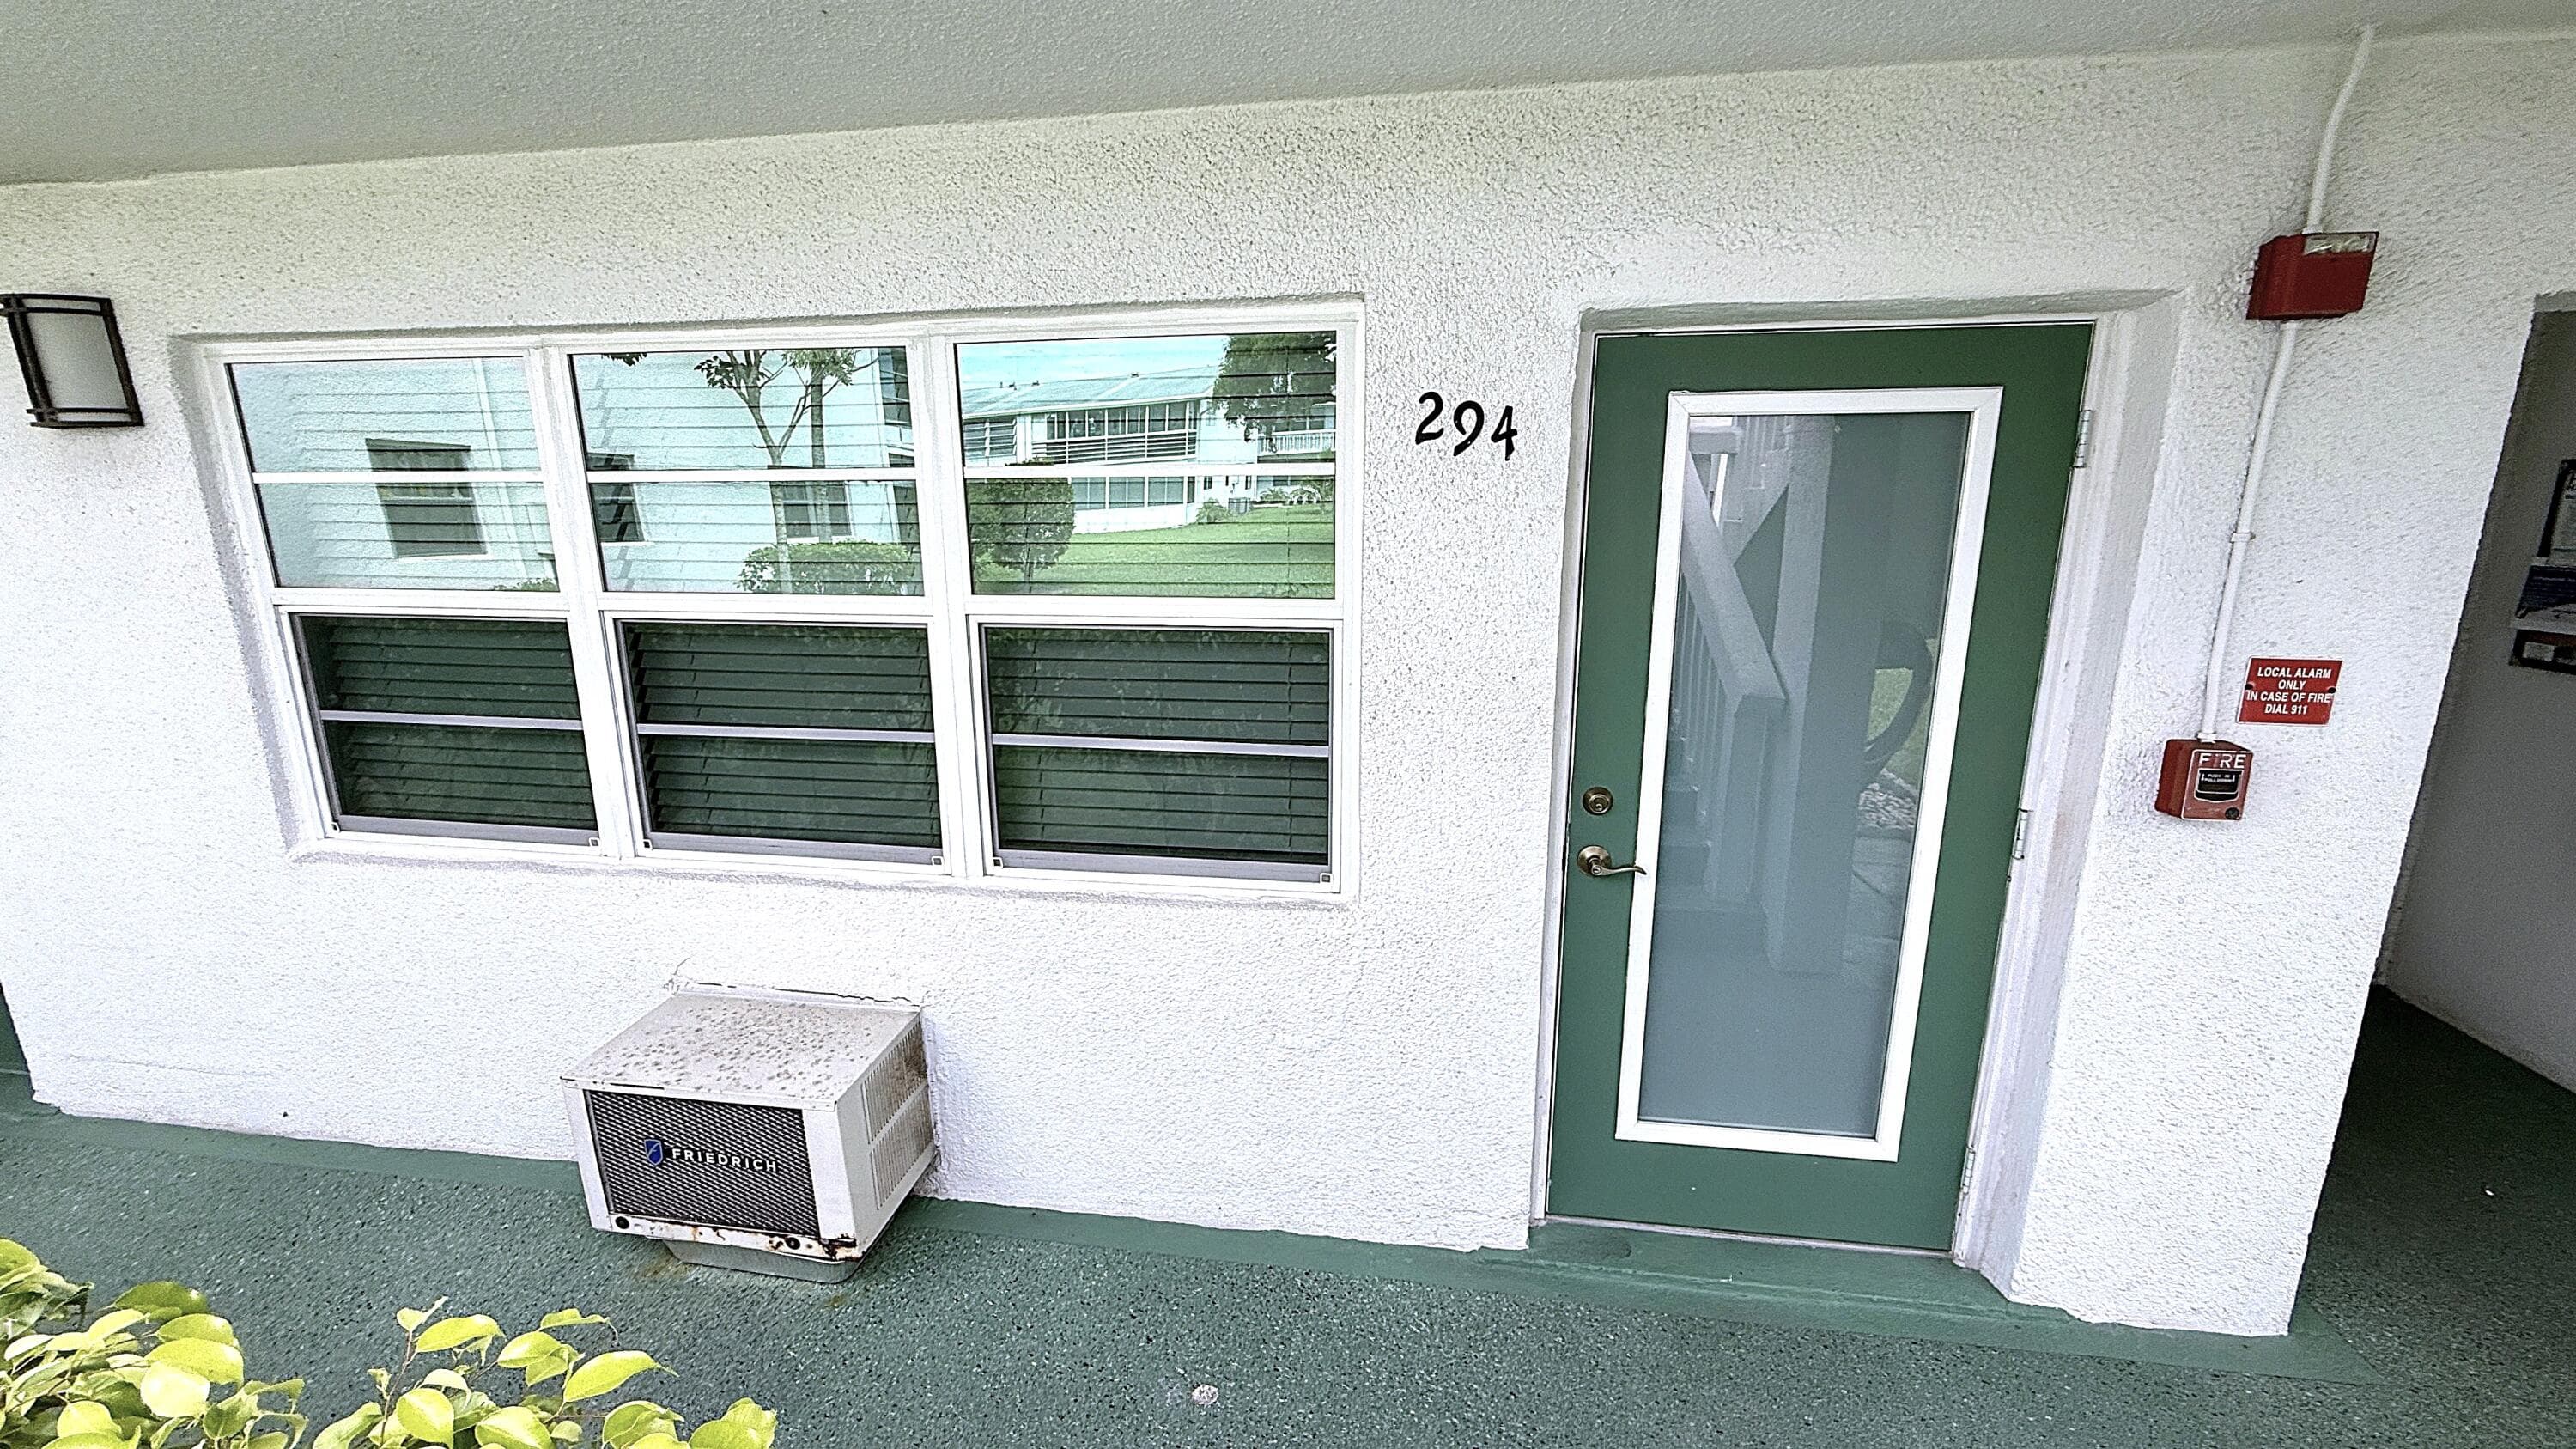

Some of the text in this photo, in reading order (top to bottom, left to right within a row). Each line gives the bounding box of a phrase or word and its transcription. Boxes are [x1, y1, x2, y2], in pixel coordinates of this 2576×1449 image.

[1415, 391, 1518, 461] 294
[2257, 667, 2331, 679] LOCAL ALARM
[2278, 679, 2306, 690] ONLY
[2246, 691, 2331, 703] IN CASE OF FIRE
[2265, 704, 2308, 715] DIAL 911
[2198, 752, 2246, 768] FIRE
[671, 1148, 776, 1172] FRIEDRICH
